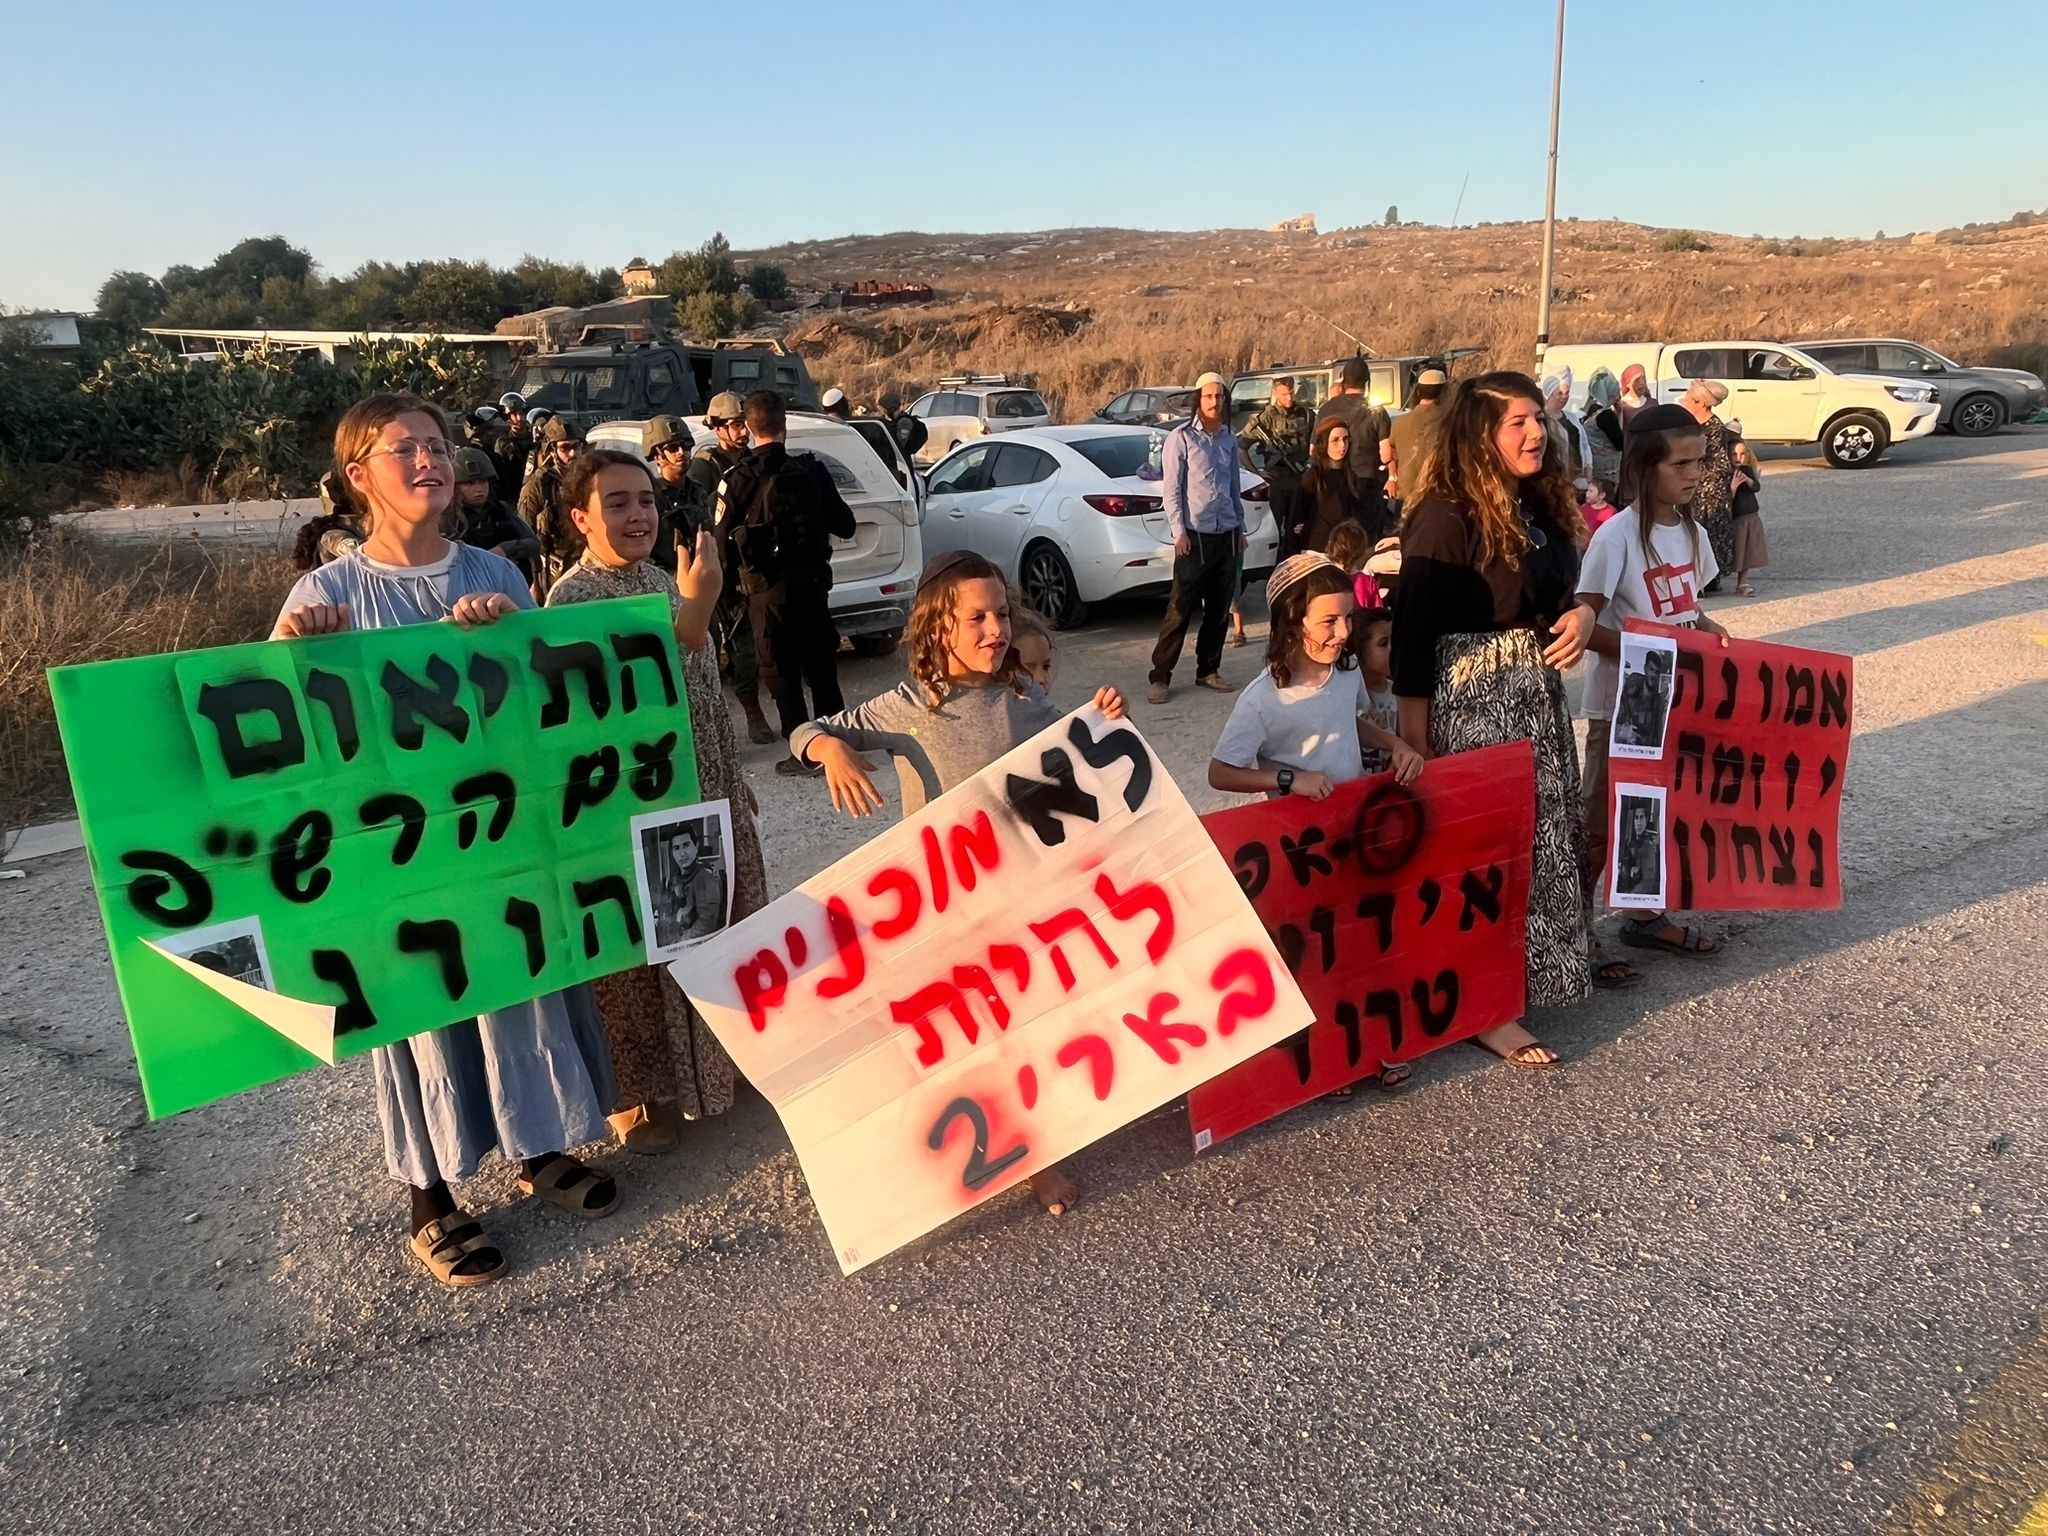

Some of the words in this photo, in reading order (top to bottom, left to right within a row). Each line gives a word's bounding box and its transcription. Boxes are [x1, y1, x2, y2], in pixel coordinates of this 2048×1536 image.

[197, 631, 679, 779] התיאום
[1671, 648, 1847, 729] אמונה
[561, 731, 678, 829] עם
[1006, 716, 1152, 847] לא
[1675, 731, 1837, 811] יוזמה
[1673, 816, 1824, 910] נצחון
[311, 872, 644, 1038] הורג
[733, 809, 1003, 1034] מוכנים
[887, 872, 1176, 1068] להיות
[930, 1097, 1029, 1190] 2
